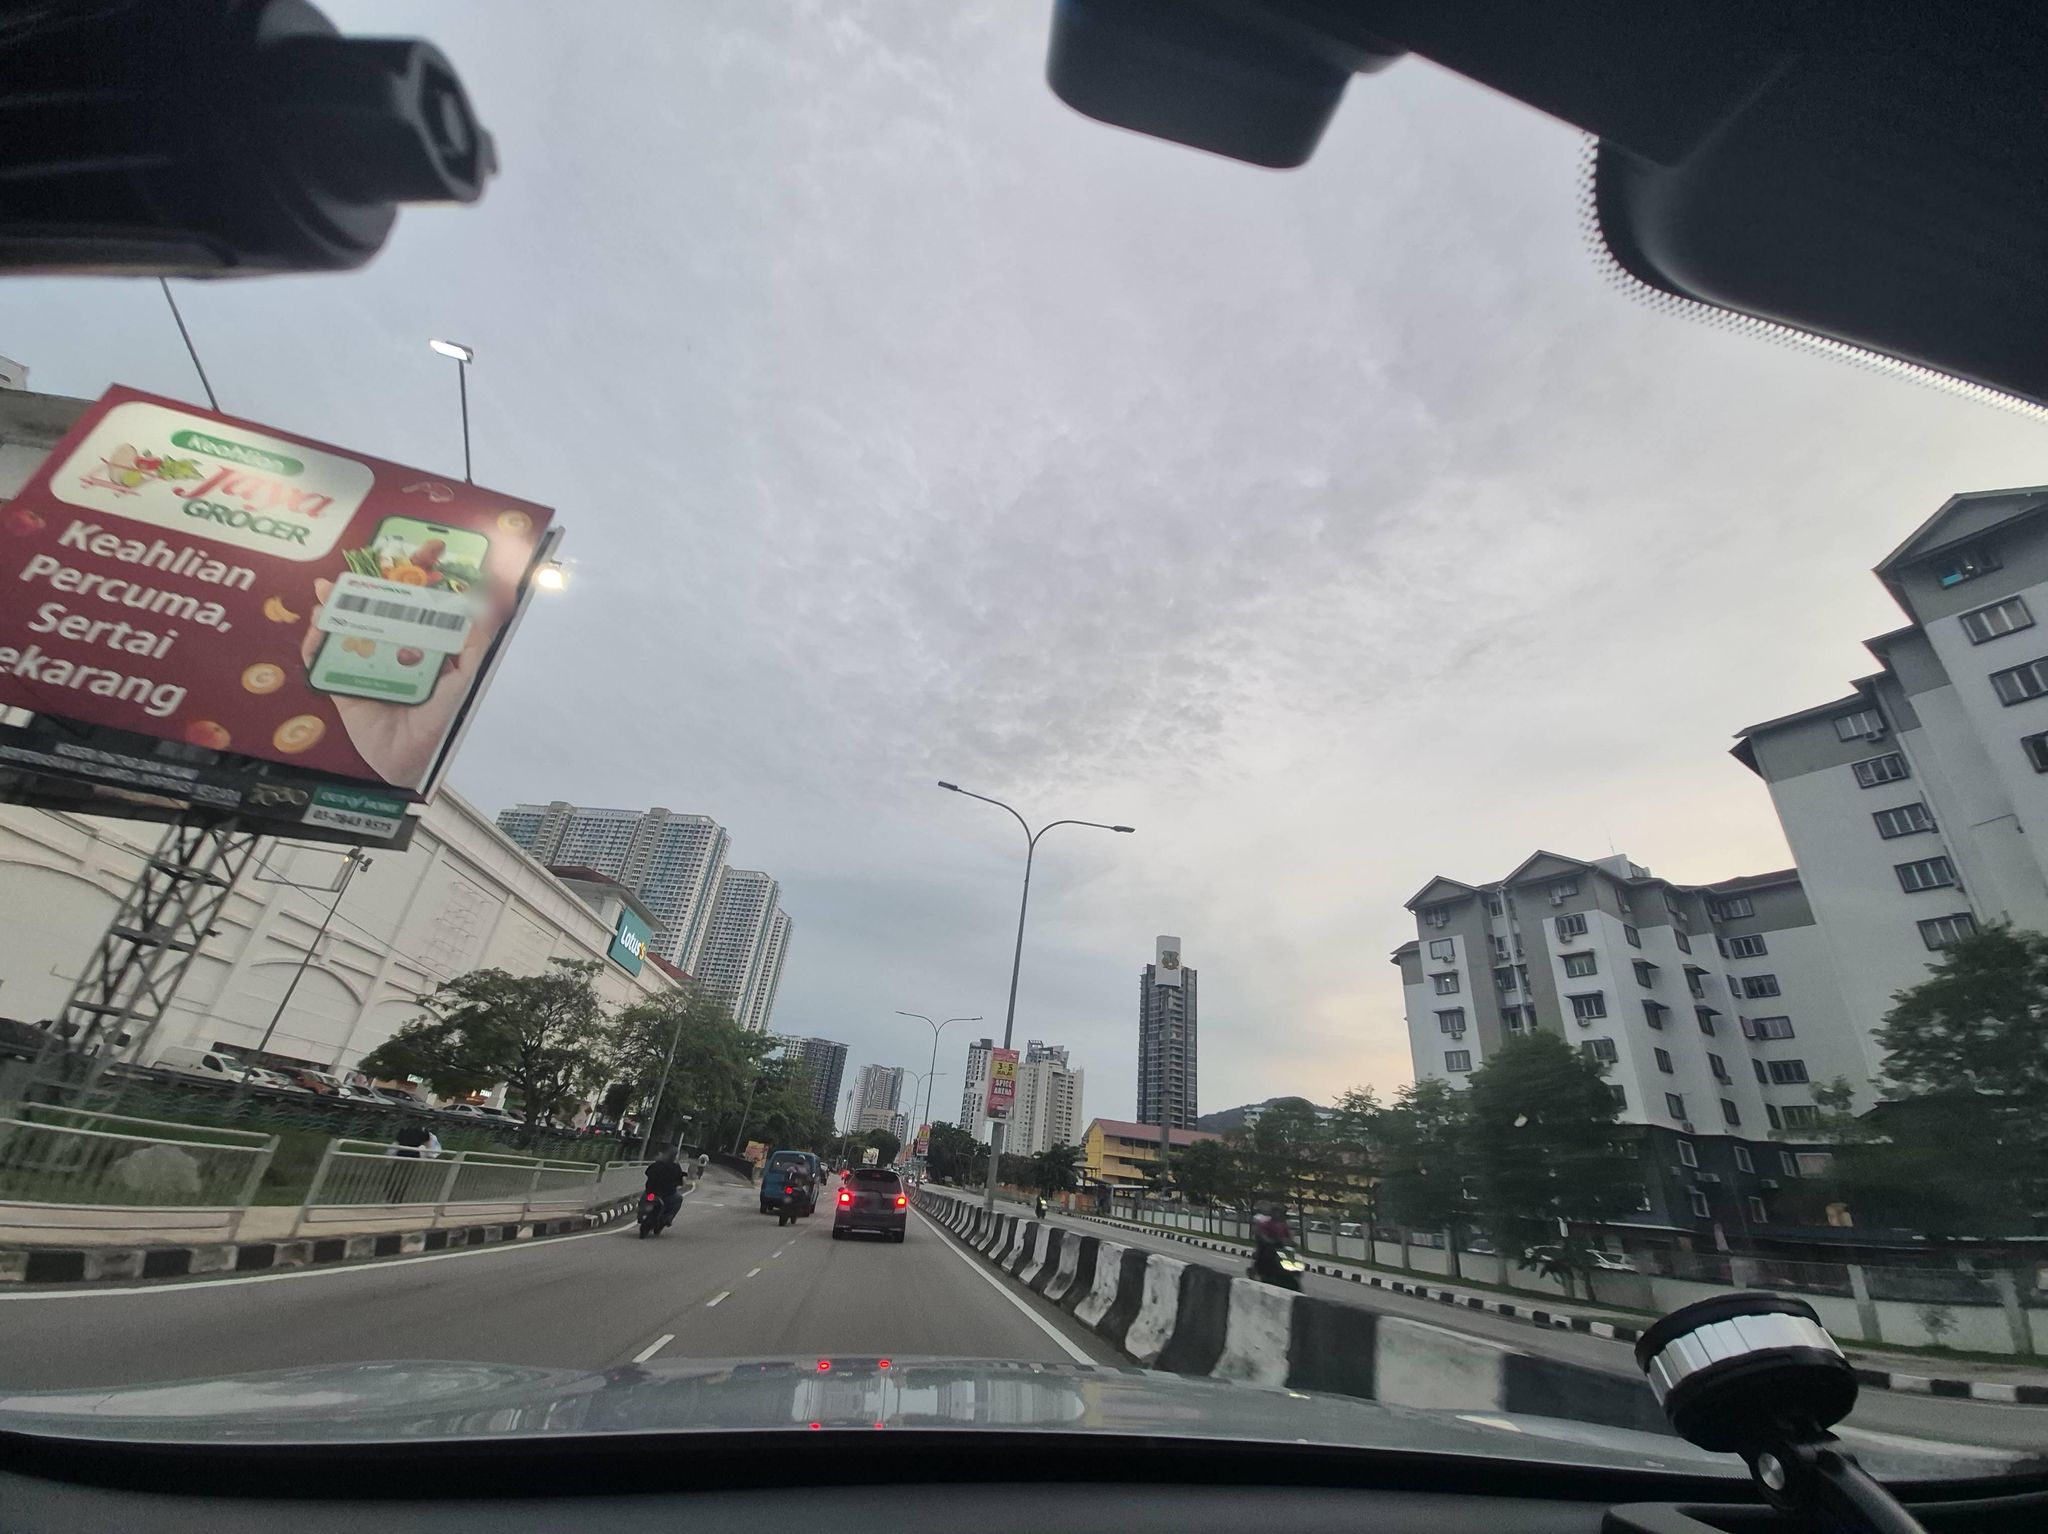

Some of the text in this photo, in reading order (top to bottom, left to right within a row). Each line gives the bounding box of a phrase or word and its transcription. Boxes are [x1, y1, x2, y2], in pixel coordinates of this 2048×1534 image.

[182, 498, 312, 547] GROCER
[57, 519, 257, 592] Keahlian
[19, 553, 233, 634] Percuma,
[28, 601, 180, 660] Sertai
[620, 924, 646, 961] Lotus's
